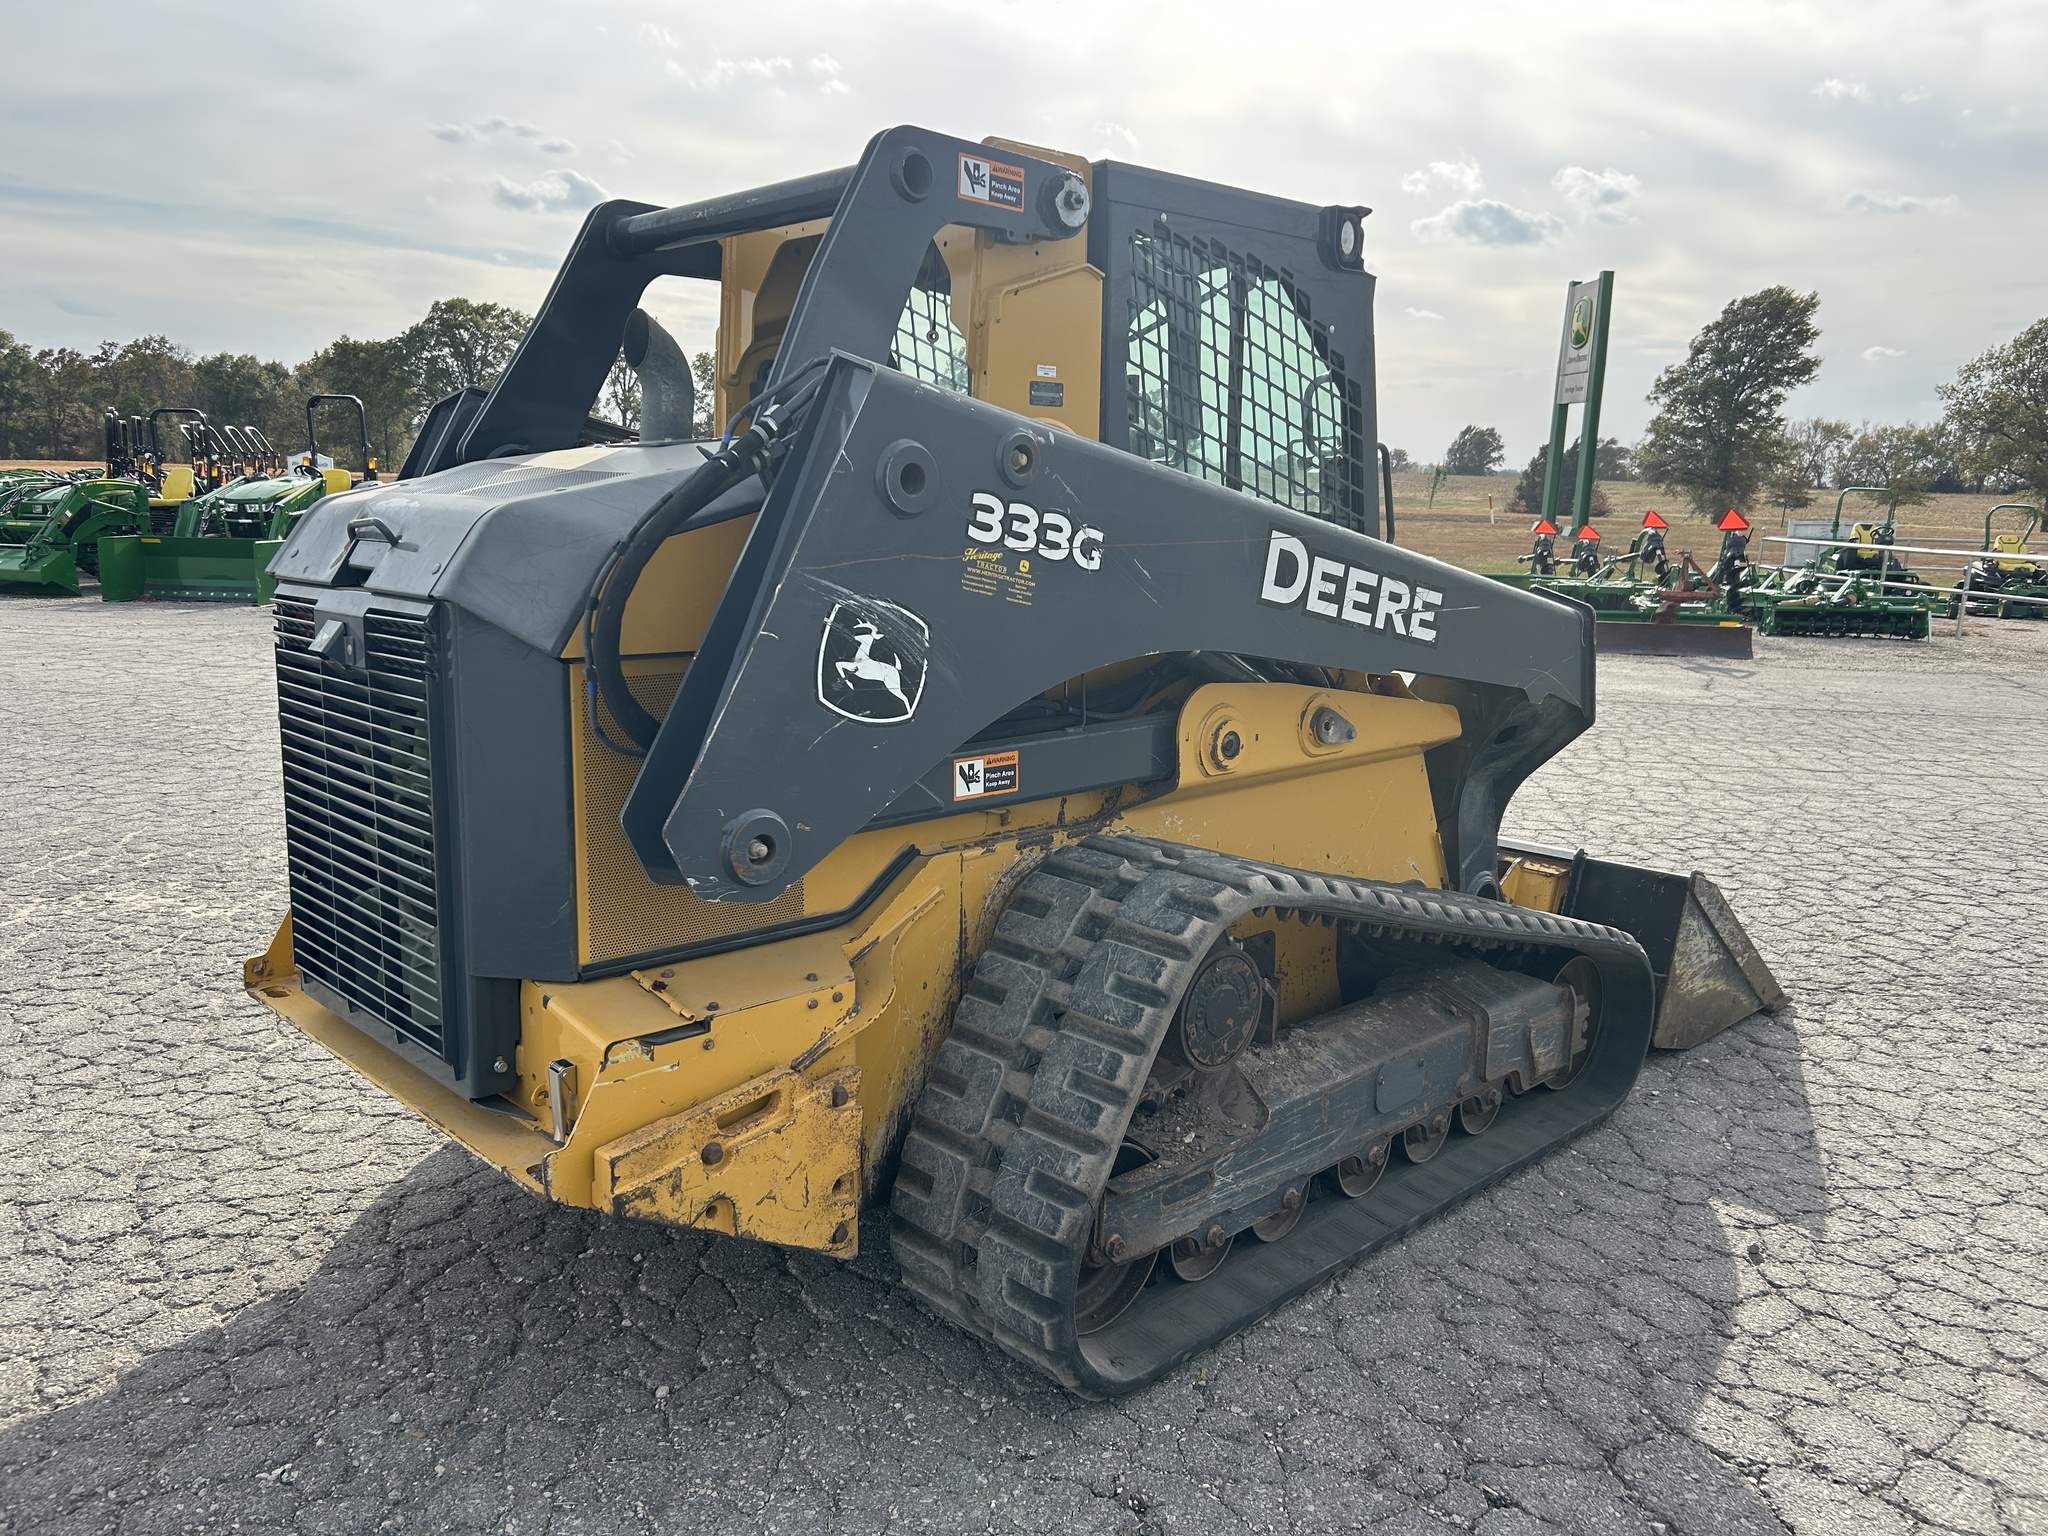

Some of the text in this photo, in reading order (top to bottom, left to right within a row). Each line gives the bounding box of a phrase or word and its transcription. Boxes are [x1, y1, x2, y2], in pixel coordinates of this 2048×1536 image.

[998, 166, 1022, 178] WARNING
[991, 180, 1021, 194] Pinch Area
[991, 190, 1017, 202] Keep Away
[967, 493, 1104, 570] 333G
[962, 547, 1004, 562] Heritage
[976, 560, 1008, 574] TRACTOR
[1261, 529, 1443, 643] DEERE
[991, 755, 1016, 764] WARNING
[985, 772, 1001, 780] Pinch
